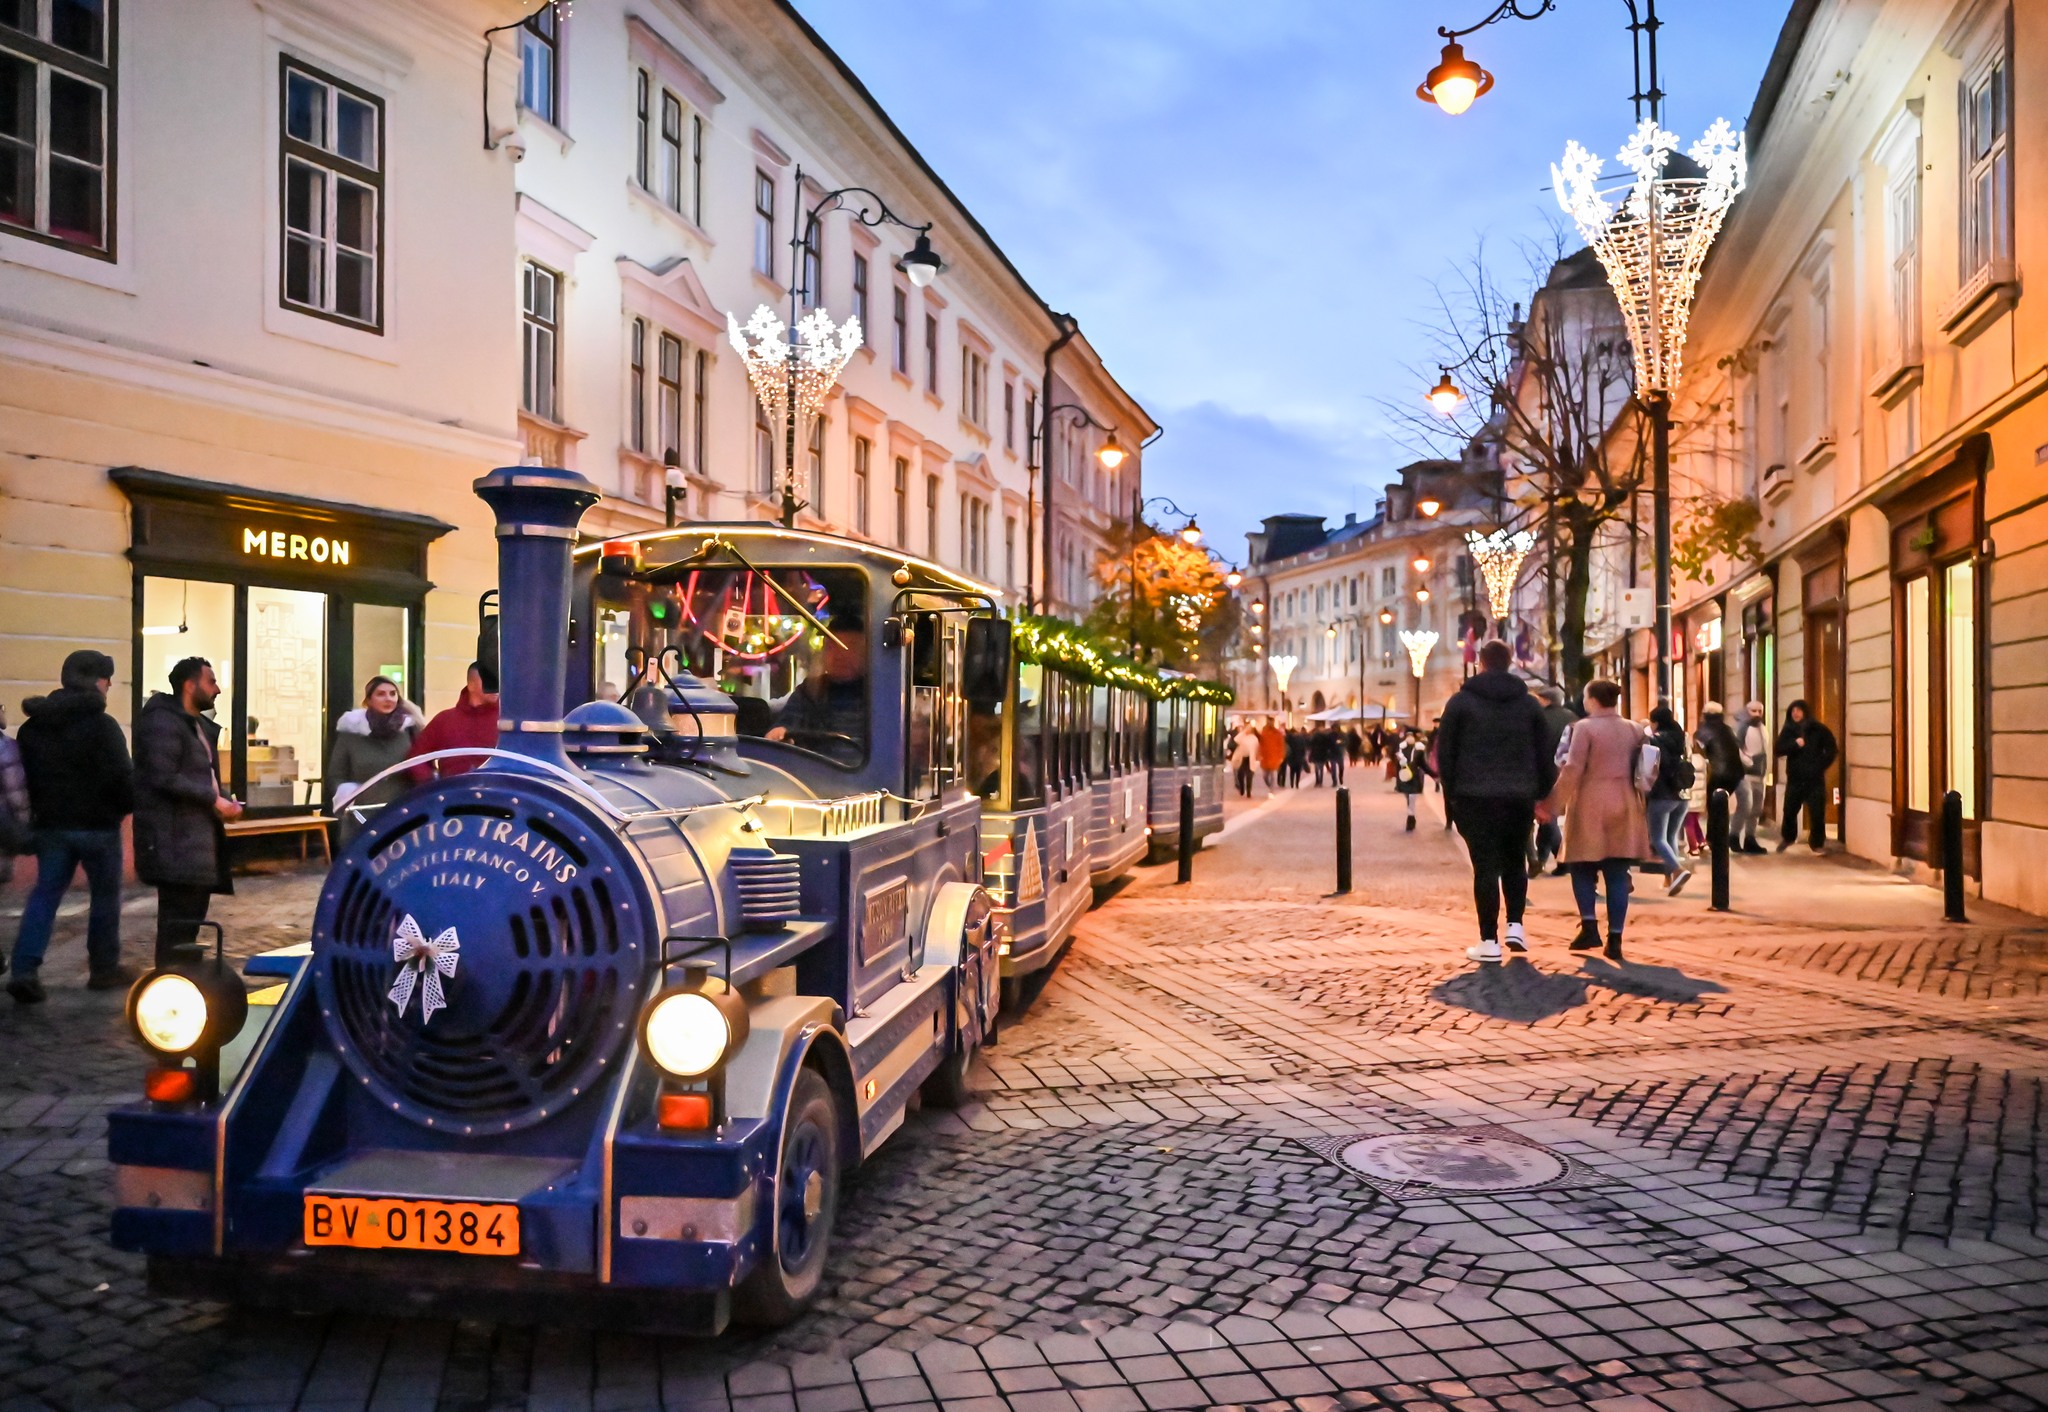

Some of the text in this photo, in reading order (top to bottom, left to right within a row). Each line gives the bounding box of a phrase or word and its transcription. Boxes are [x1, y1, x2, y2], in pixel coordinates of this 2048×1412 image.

[243, 527, 349, 565] MERON
[371, 818, 577, 884] DOTTO TRAINS
[432, 872, 487, 890] ITALY
[313, 1203, 505, 1247] BV 01384
